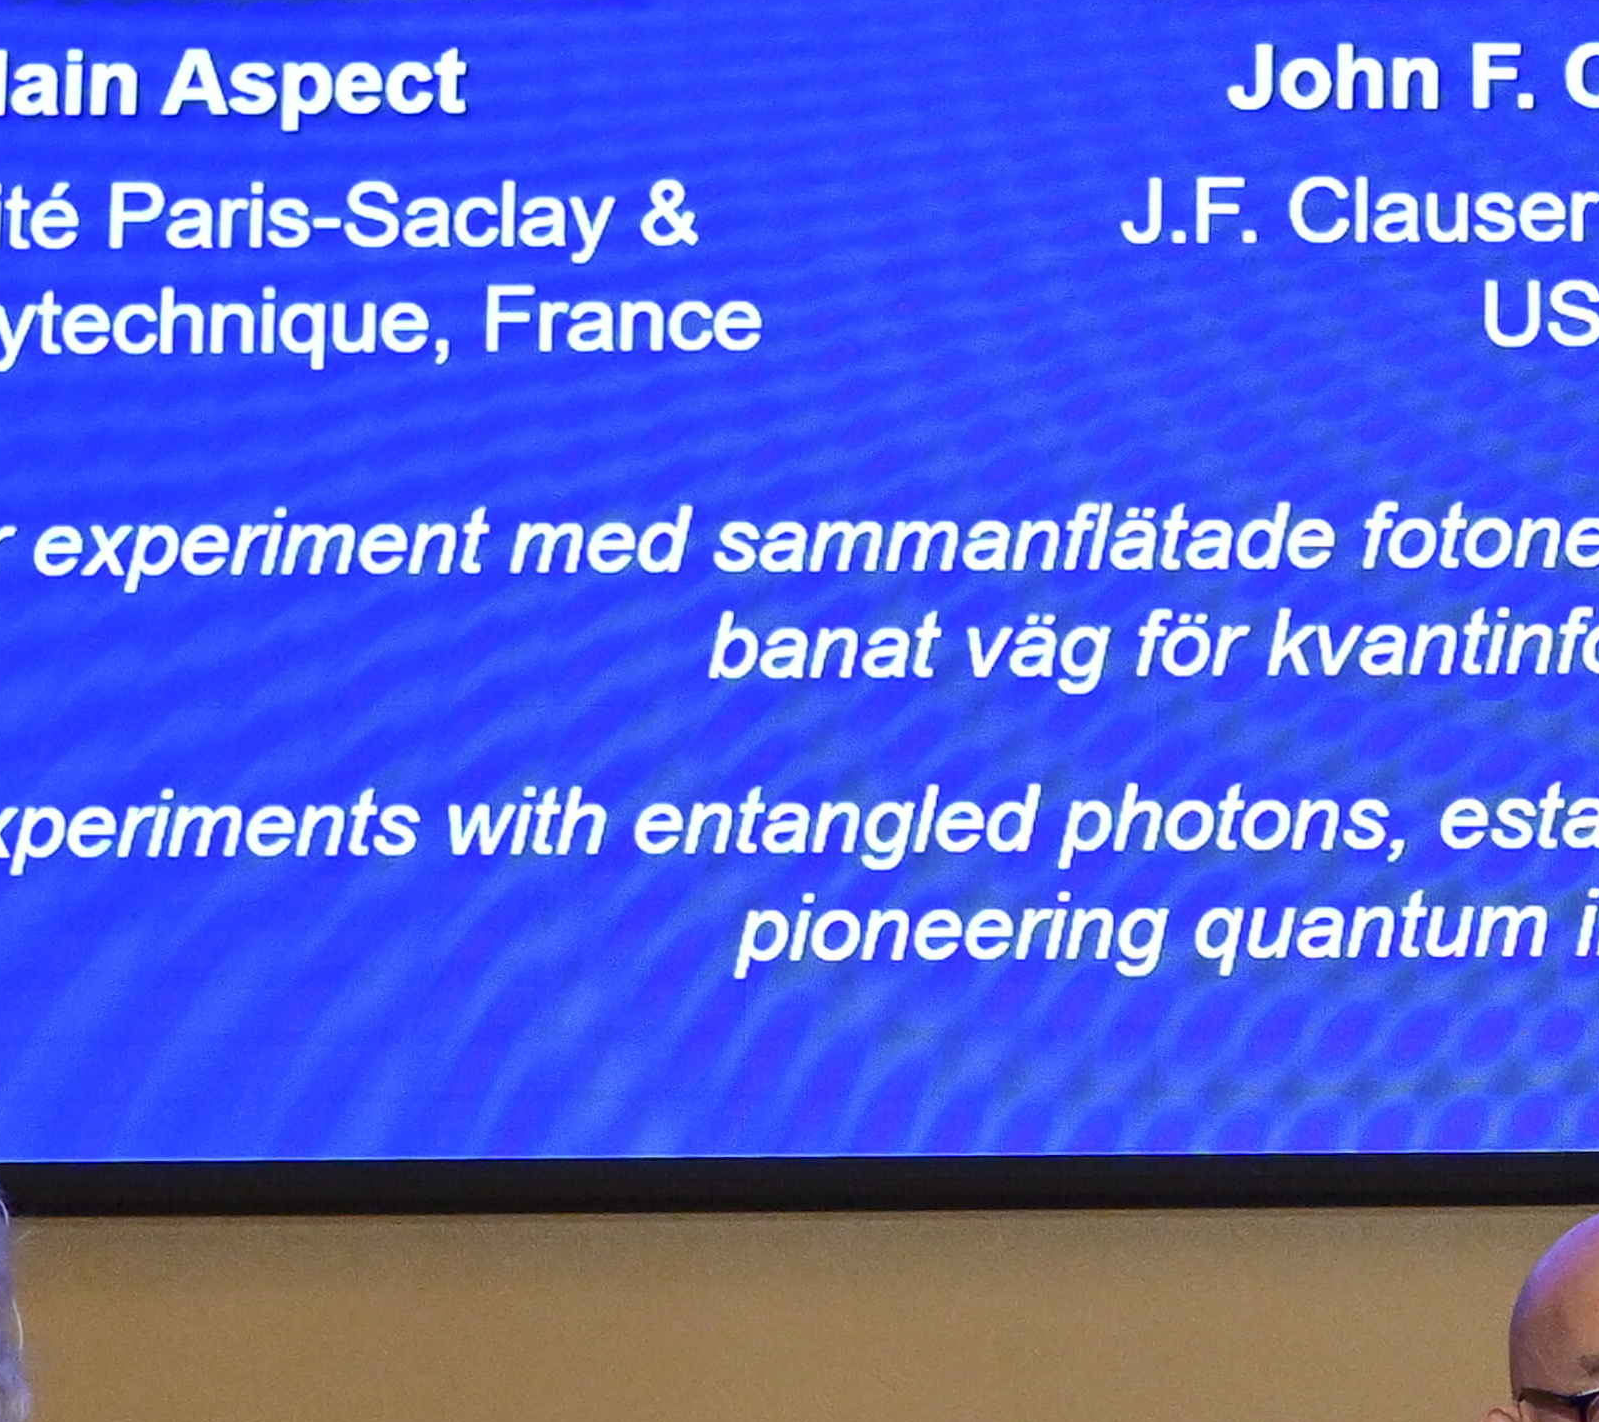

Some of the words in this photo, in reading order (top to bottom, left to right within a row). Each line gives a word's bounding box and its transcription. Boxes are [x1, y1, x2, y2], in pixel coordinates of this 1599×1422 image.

[159, 46, 468, 133] Aspect
[1226, 42, 1440, 112] John
[1471, 41, 1535, 111] F.
[107, 178, 617, 265] Paris-Saclay
[639, 177, 700, 248] &
[1119, 175, 1259, 246] J.F.
[484, 283, 763, 354] France
[32, 505, 491, 595] experiment
[508, 503, 694, 575] med
[712, 500, 1336, 574] sammanflätade
[707, 609, 943, 680] banat
[965, 612, 1113, 696] väg
[1135, 607, 1252, 678] för
[447, 784, 608, 857] with
[633, 782, 1043, 872] entangled
[1056, 781, 1406, 871] photons,
[732, 889, 1171, 981] pioneering
[1193, 888, 1549, 978] quantum
